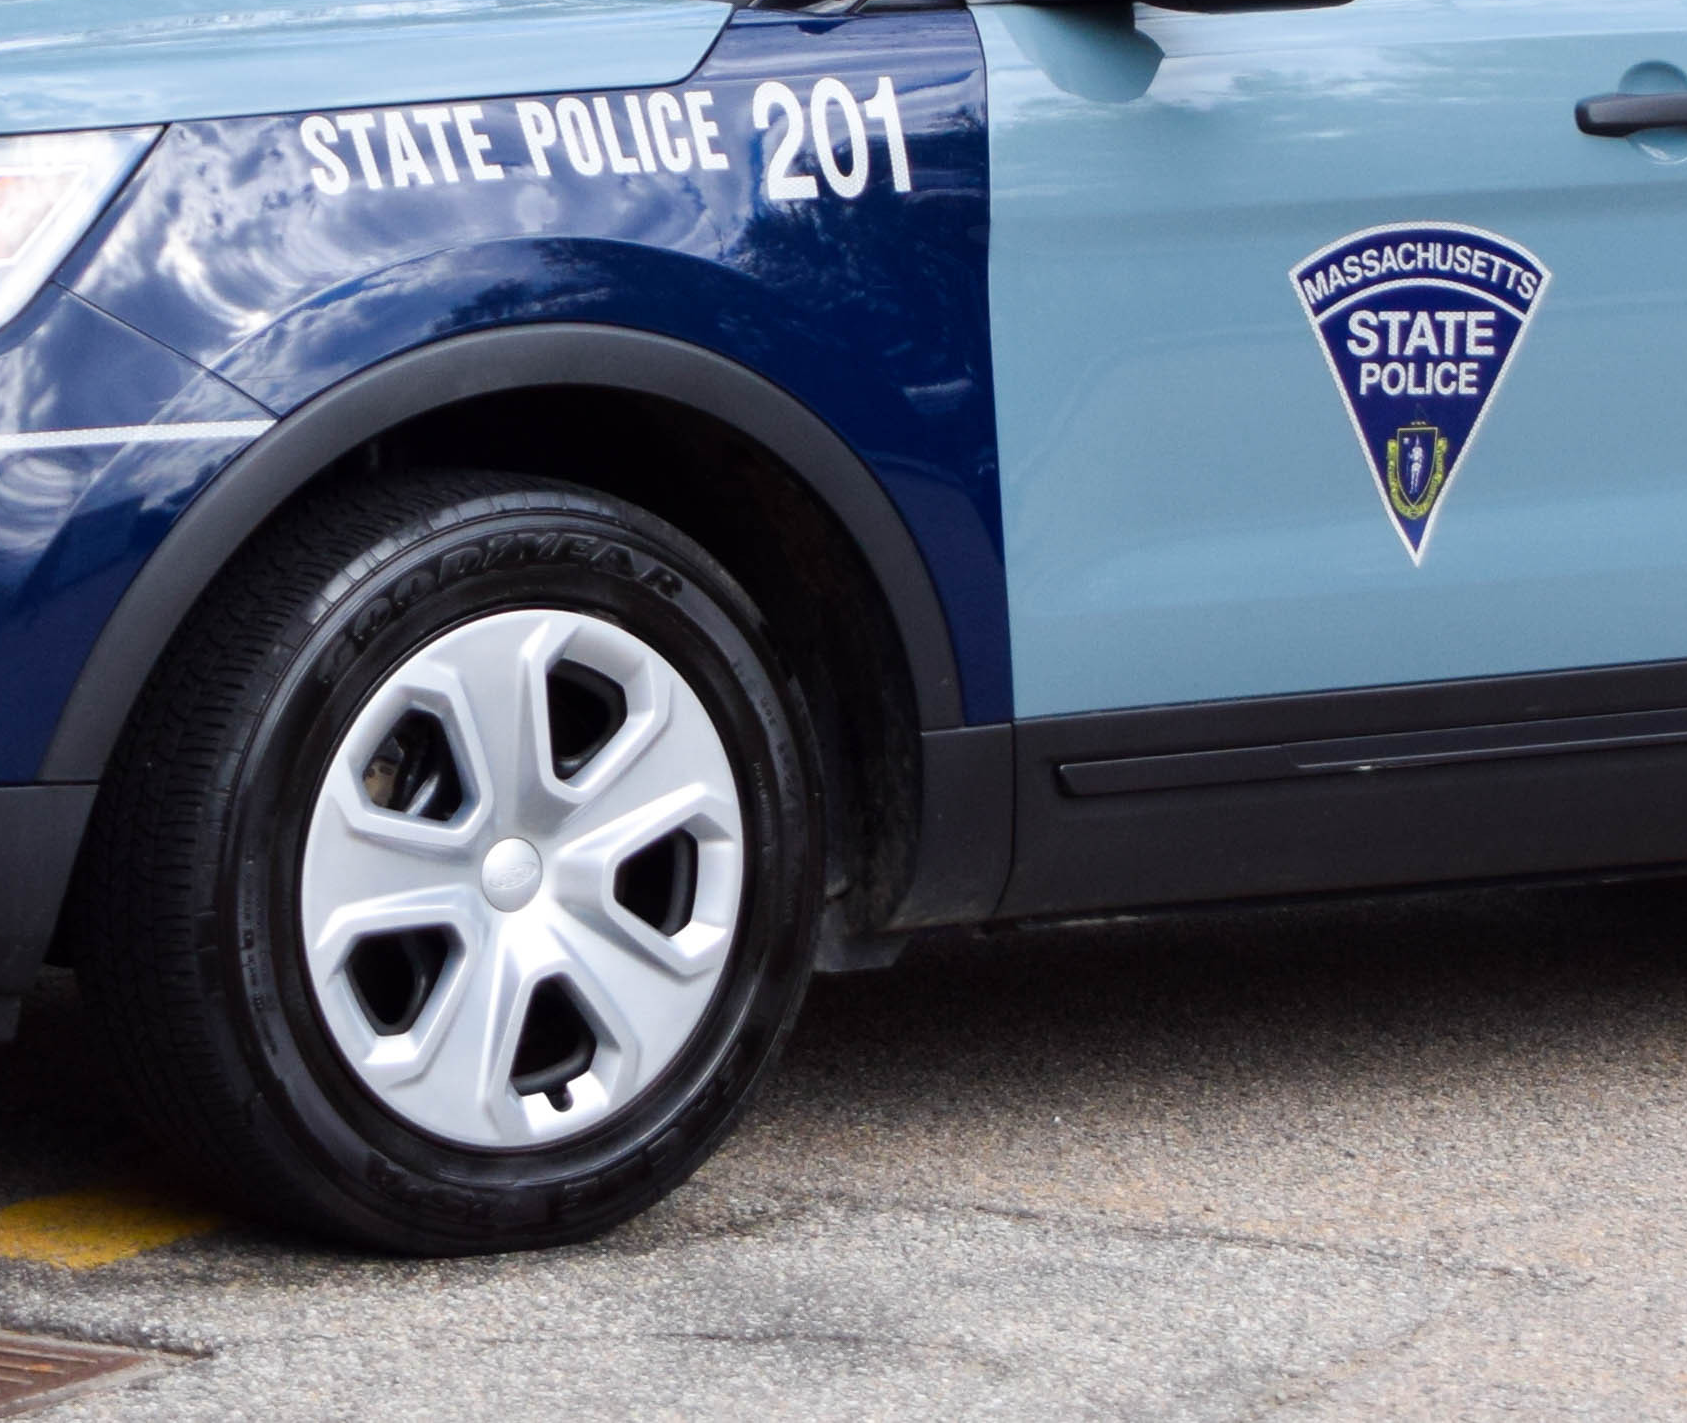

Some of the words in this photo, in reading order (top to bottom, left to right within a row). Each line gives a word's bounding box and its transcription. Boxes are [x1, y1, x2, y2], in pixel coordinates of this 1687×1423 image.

[300, 104, 505, 196] STATE
[515, 91, 729, 177] POLICE
[752, 76, 911, 200] 201
[1302, 242, 1538, 305] MASSACHUSETTS
[1347, 310, 1496, 357] STATE
[1359, 361, 1479, 396] POLICE
